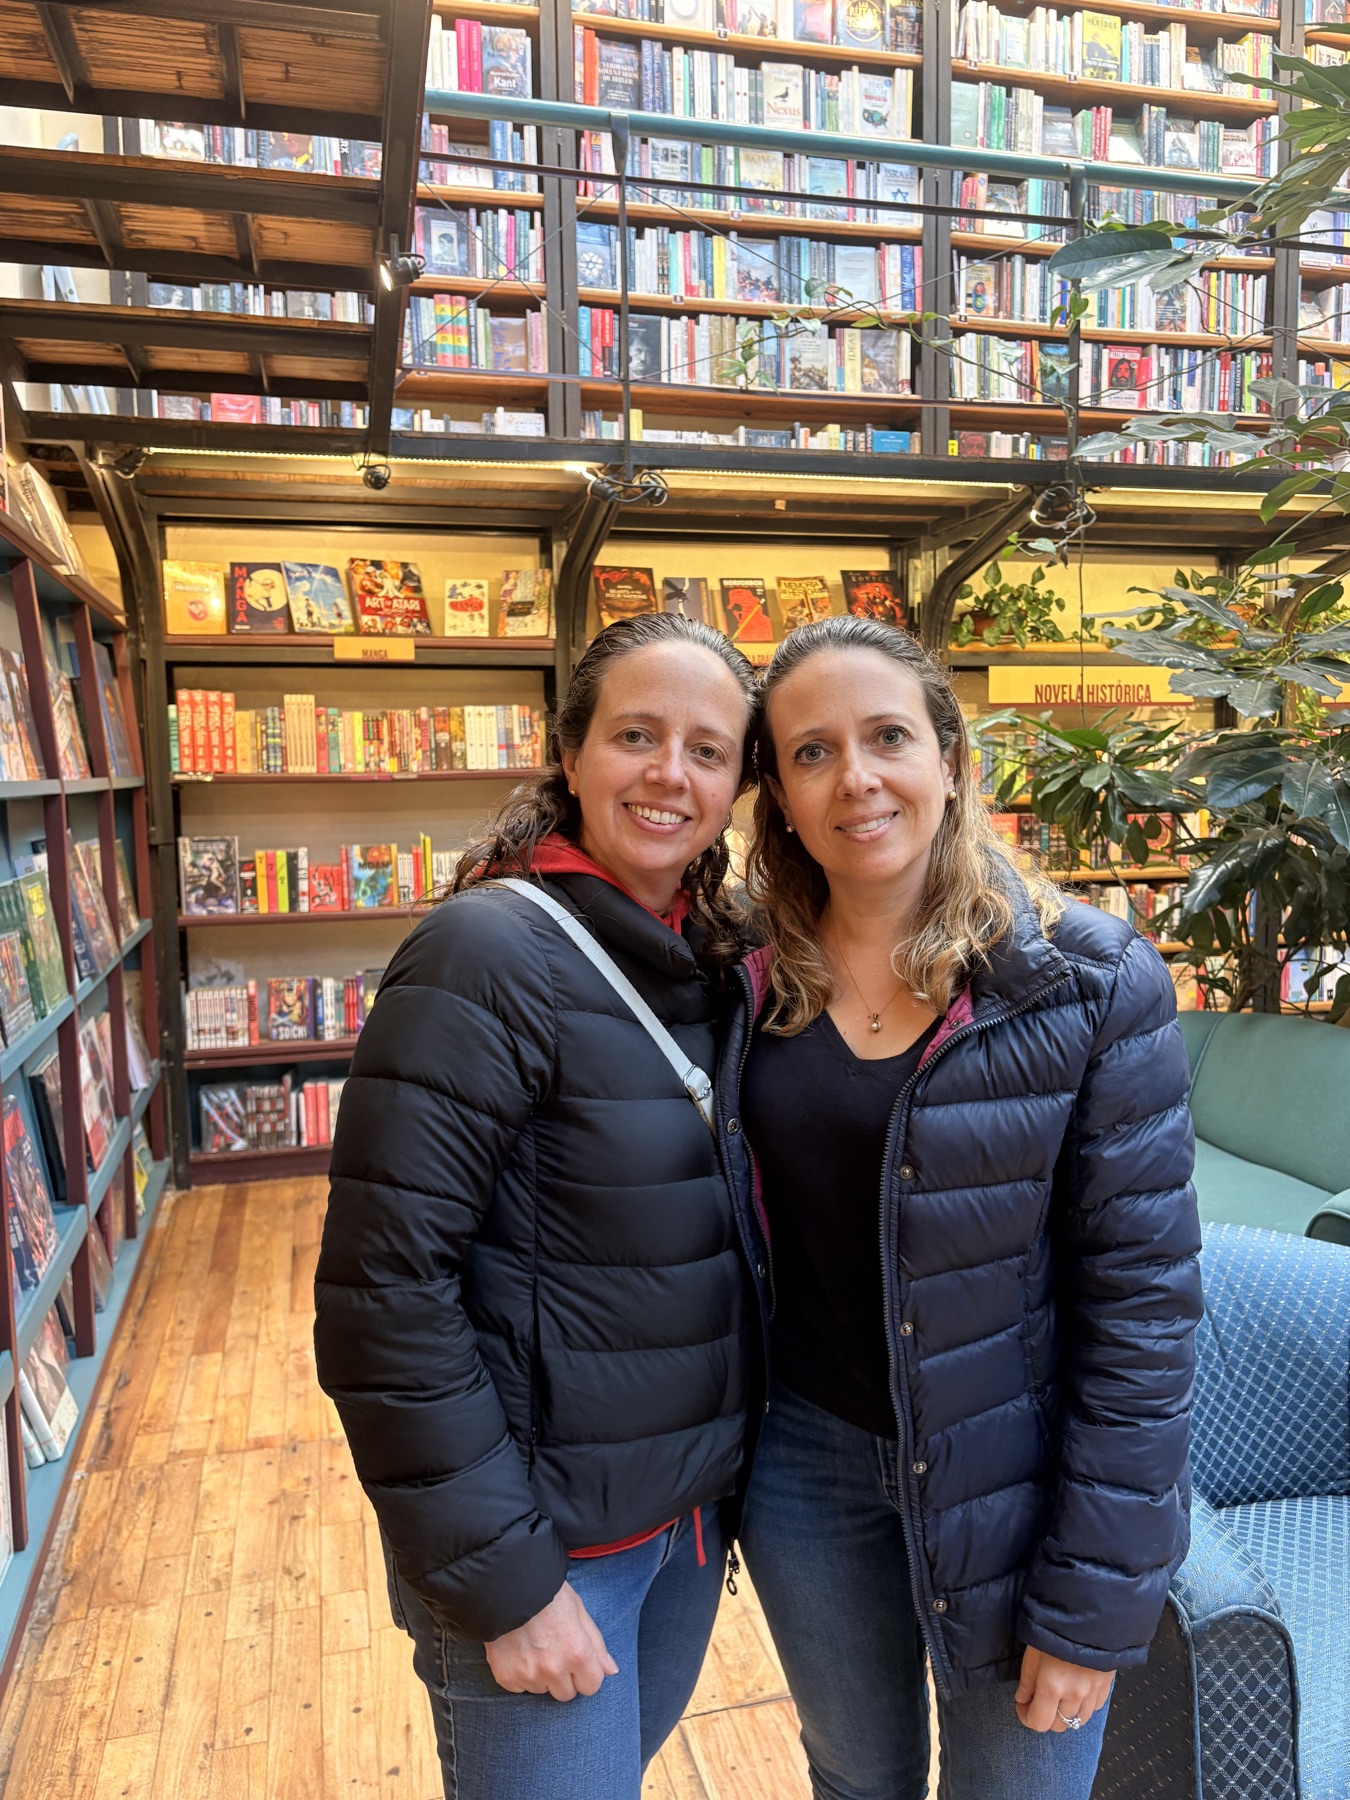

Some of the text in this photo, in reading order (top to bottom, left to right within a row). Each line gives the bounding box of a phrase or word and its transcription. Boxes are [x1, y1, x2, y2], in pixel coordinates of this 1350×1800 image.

[493, 76, 517, 89] Kant
[766, 101, 801, 116] Nexus
[846, 332, 856, 361] IDEAS
[233, 565, 248, 623] MANGA
[364, 596, 385, 609] ART
[392, 597, 421, 611] ATARI
[362, 649, 388, 660] MANGA
[1035, 679, 1151, 703] NOVELA HISTÓRICA
[278, 1025, 307, 1041] SOICHI
